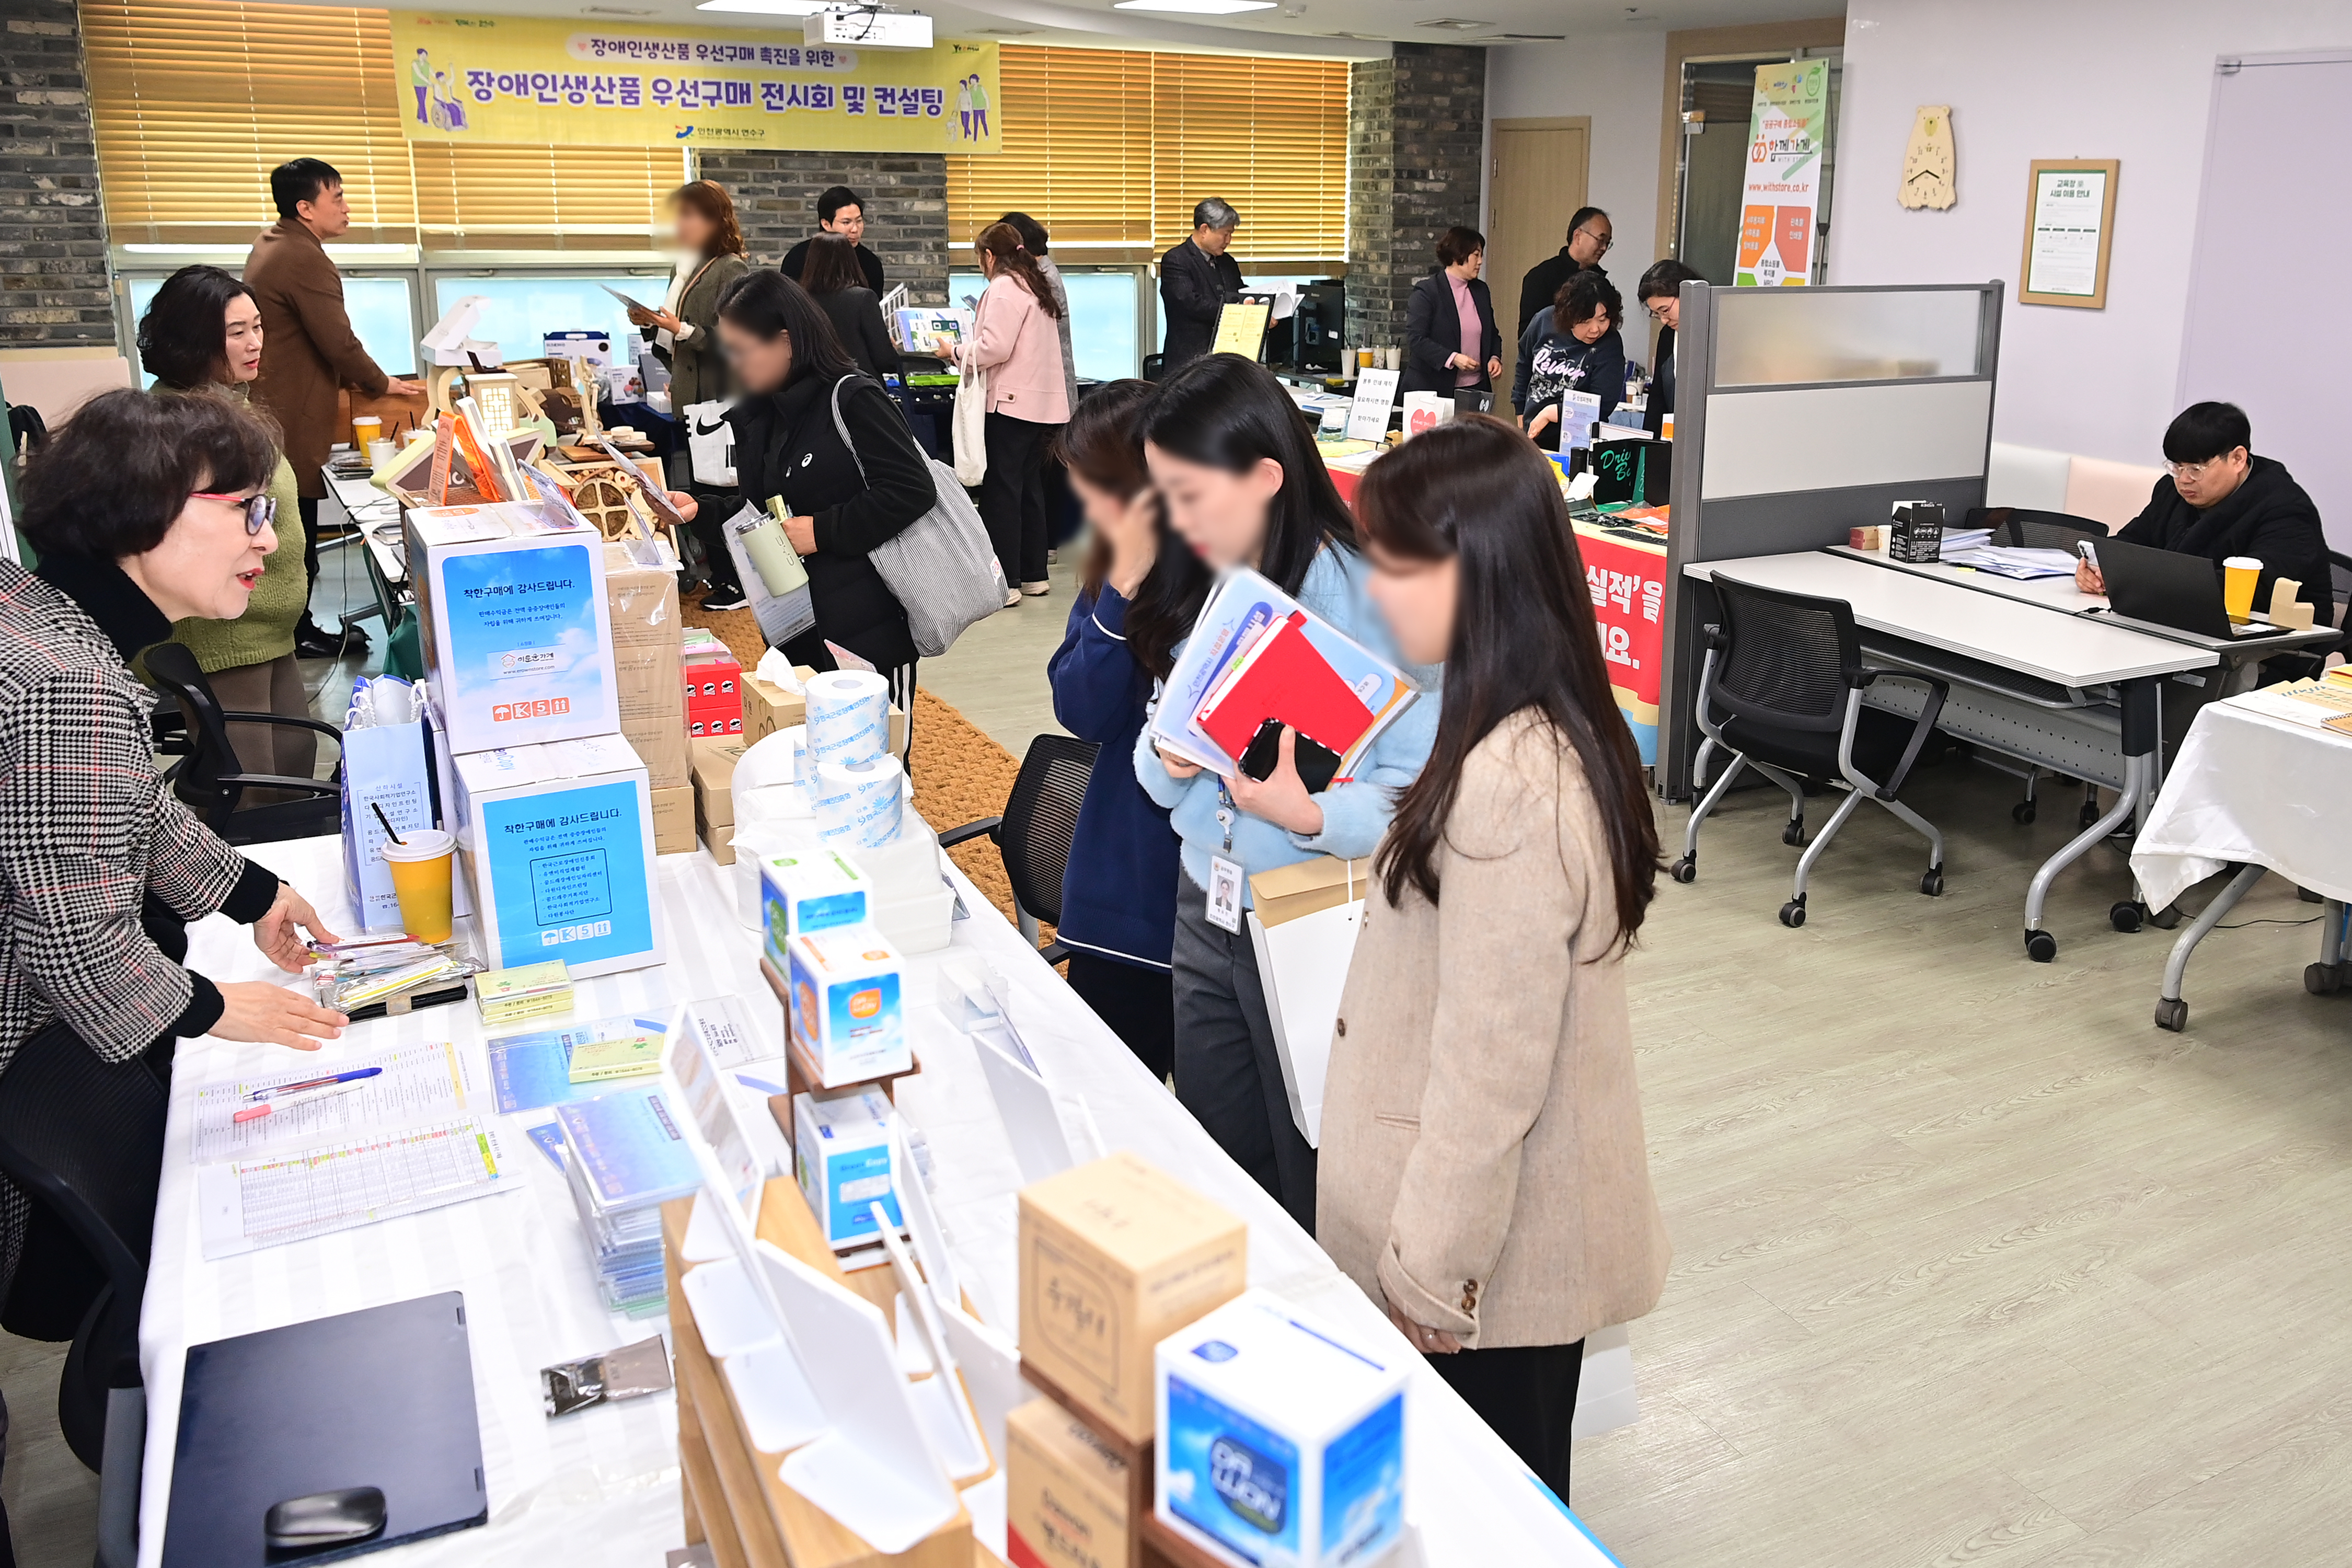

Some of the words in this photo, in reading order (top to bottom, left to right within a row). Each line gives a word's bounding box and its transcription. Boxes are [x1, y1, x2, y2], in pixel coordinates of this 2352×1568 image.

[591, 38, 690, 61] 장애인생산품
[696, 43, 755, 62] 우선구매
[760, 46, 801, 66] 촉진을
[805, 49, 835, 68] 위한
[467, 71, 640, 106] 장애인생산품
[652, 78, 752, 108] 우선구매
[760, 83, 834, 112] 전시회
[843, 86, 866, 114] 및
[874, 86, 943, 117] 컨설팅
[1357, 396, 1379, 405] 필요하시면
[464, 585, 514, 599] 착한구매에
[517, 579, 575, 595] 감사드립니다.
[478, 608, 513, 618] 판매수익금은
[503, 664, 555, 675] www.erownstore.com
[363, 790, 417, 802] 한국사회적기업연구소
[504, 818, 556, 834] 착한구매에
[559, 808, 622, 826] 감사드립니다.
